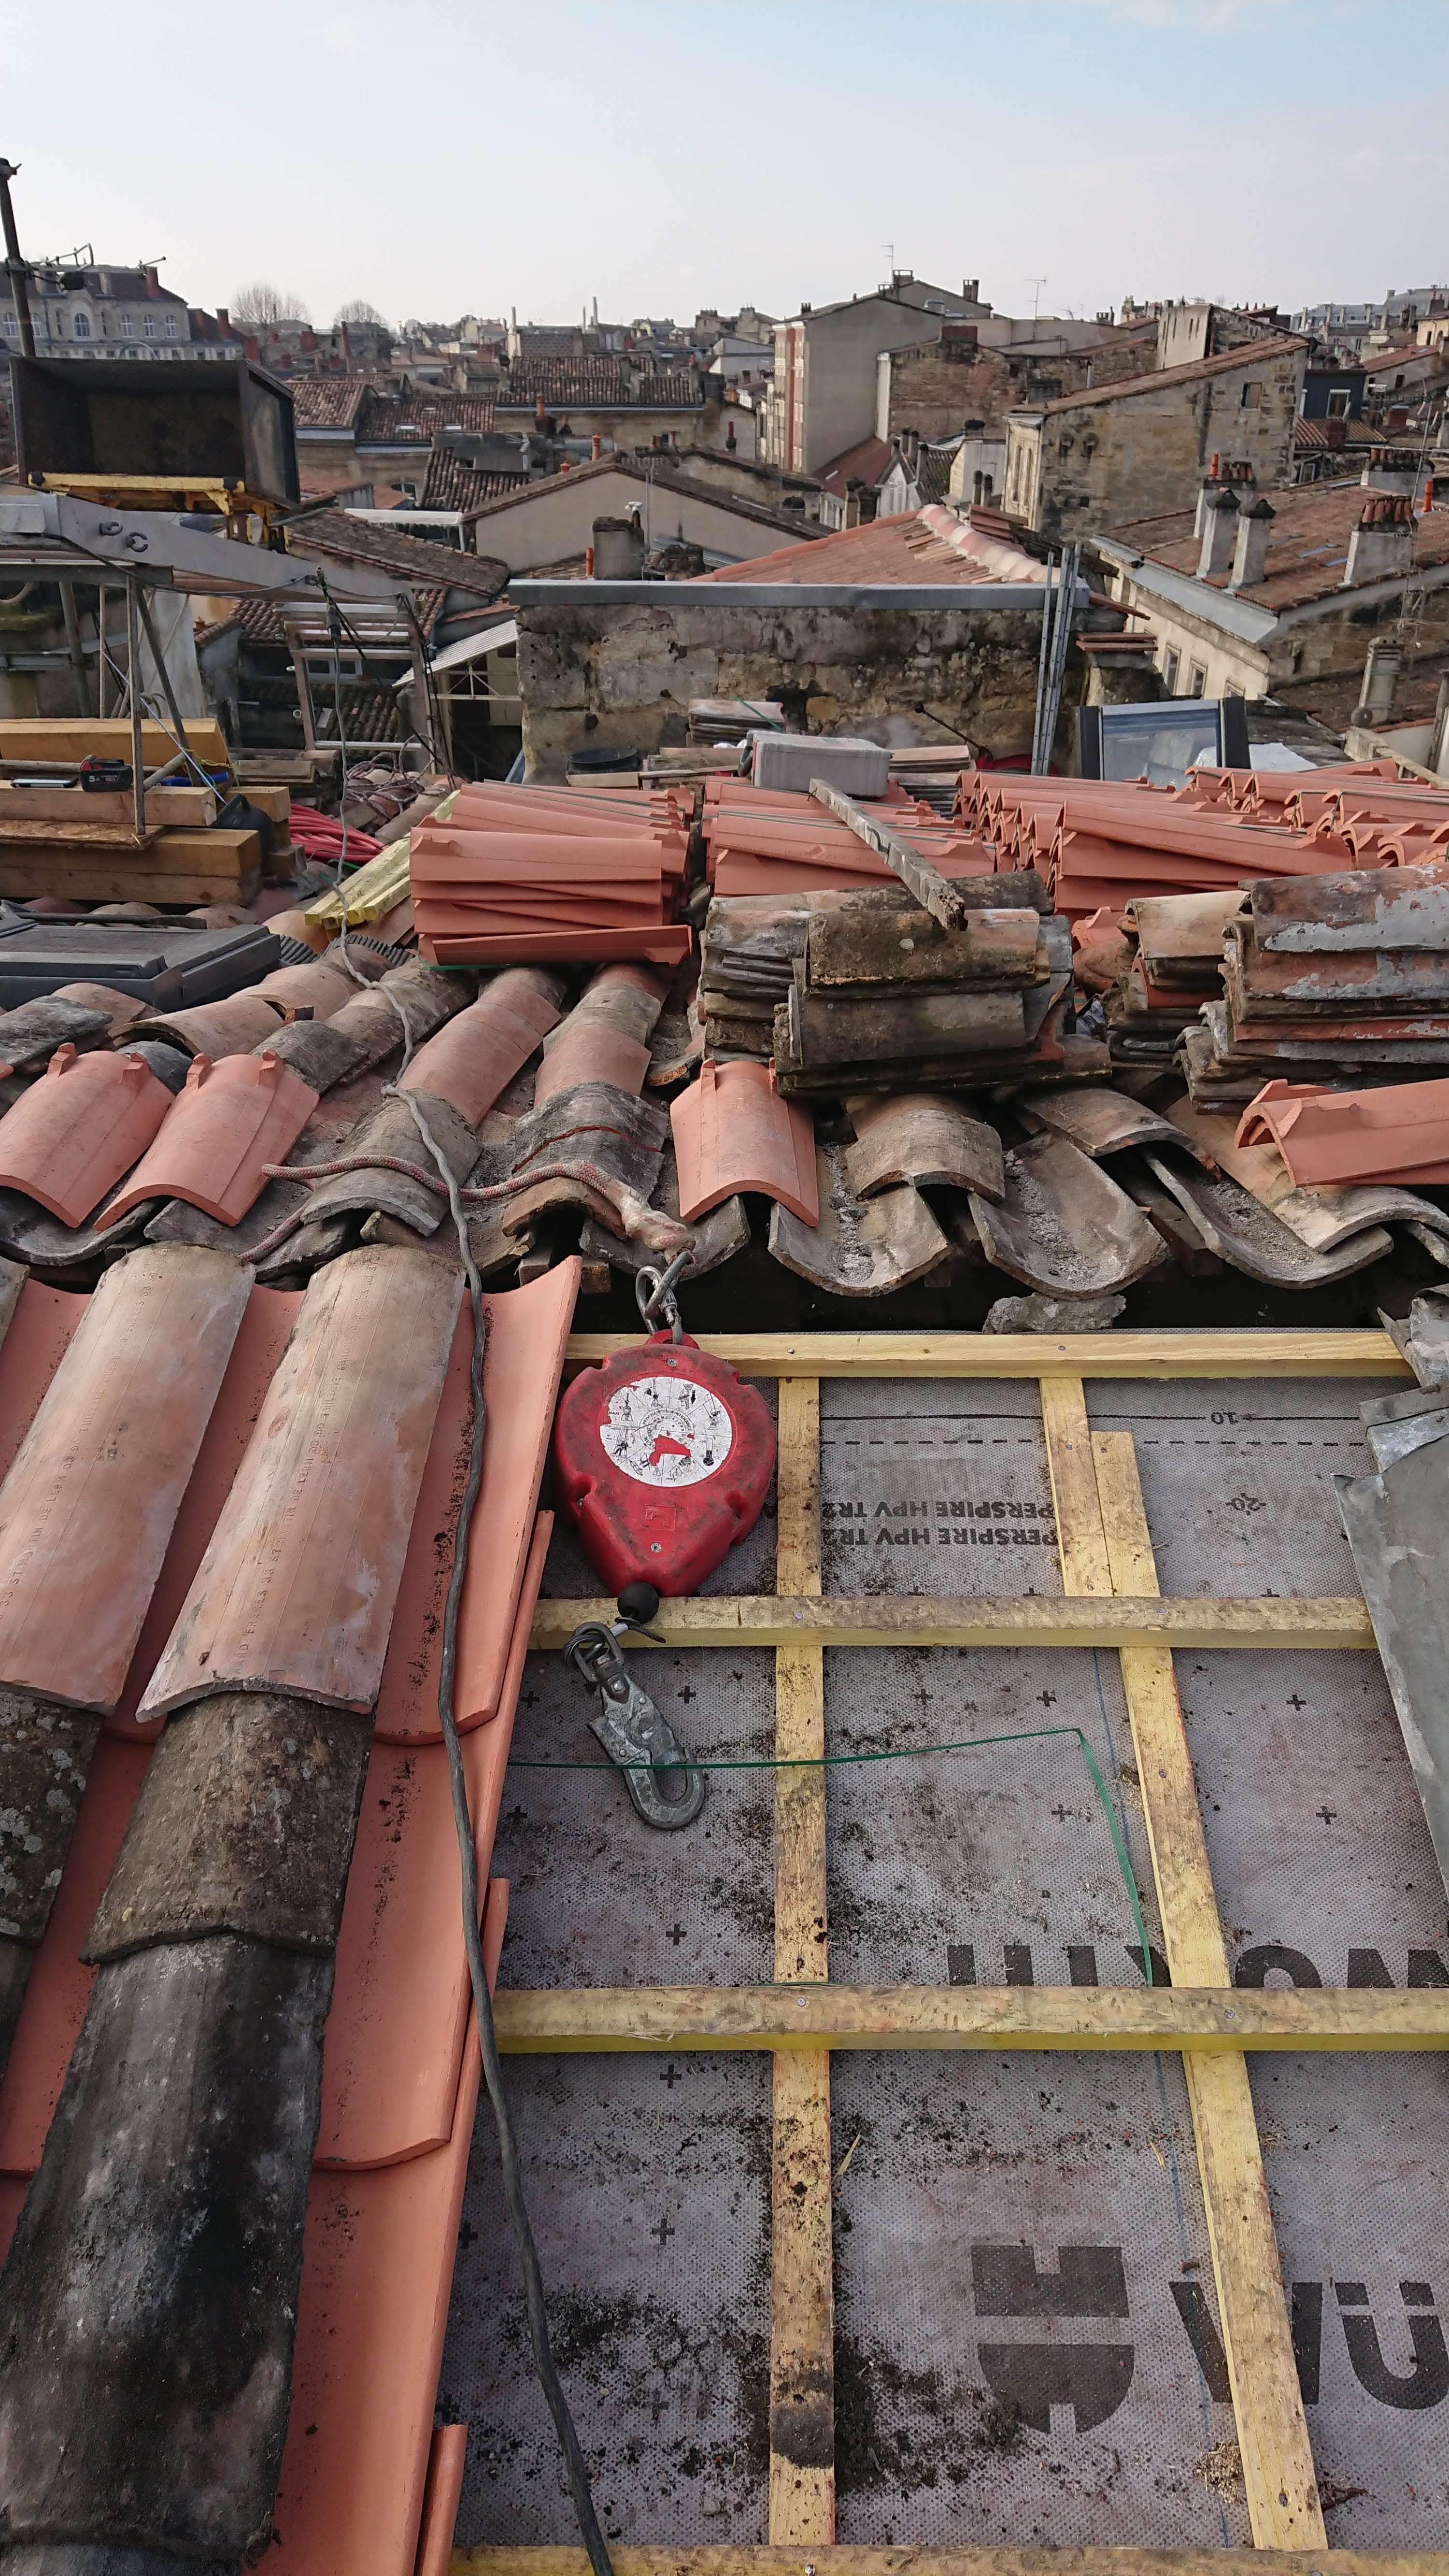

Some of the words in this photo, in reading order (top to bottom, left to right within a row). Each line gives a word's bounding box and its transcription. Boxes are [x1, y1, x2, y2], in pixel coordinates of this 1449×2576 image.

[1211, 1411, 1238, 1424] 10
[873, 1501, 928, 1517] HPV
[936, 1501, 1055, 1519] PERSPIRE
[875, 1528, 930, 1545] HPV
[938, 1528, 1058, 1545] PERSPIRE
